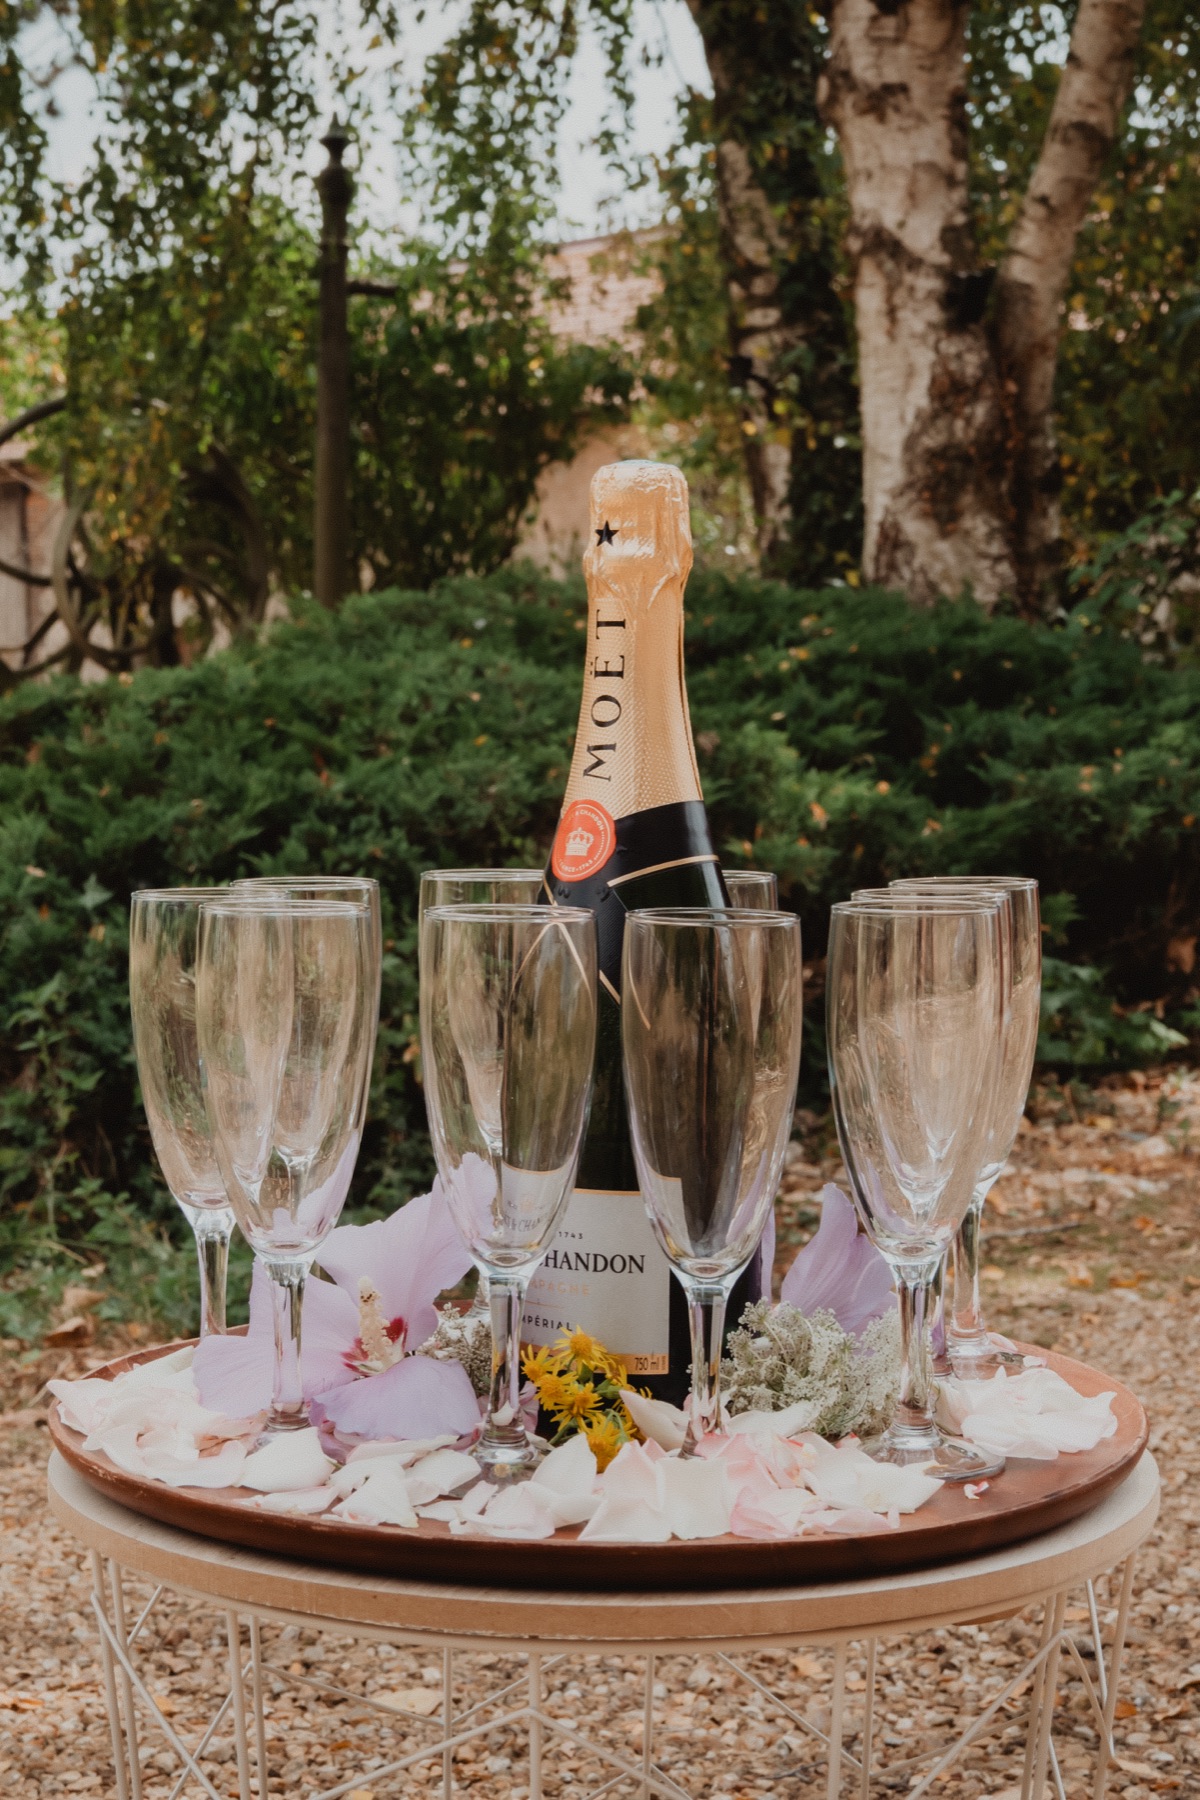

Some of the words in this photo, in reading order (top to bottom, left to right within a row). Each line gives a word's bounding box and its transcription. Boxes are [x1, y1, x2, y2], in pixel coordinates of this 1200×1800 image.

[583, 608, 626, 782] MOËT
[558, 1231, 584, 1240] 1743
[538, 1249, 646, 1274] HANDON
[634, 1357, 649, 1371] 750
[650, 1356, 660, 1371] ml
